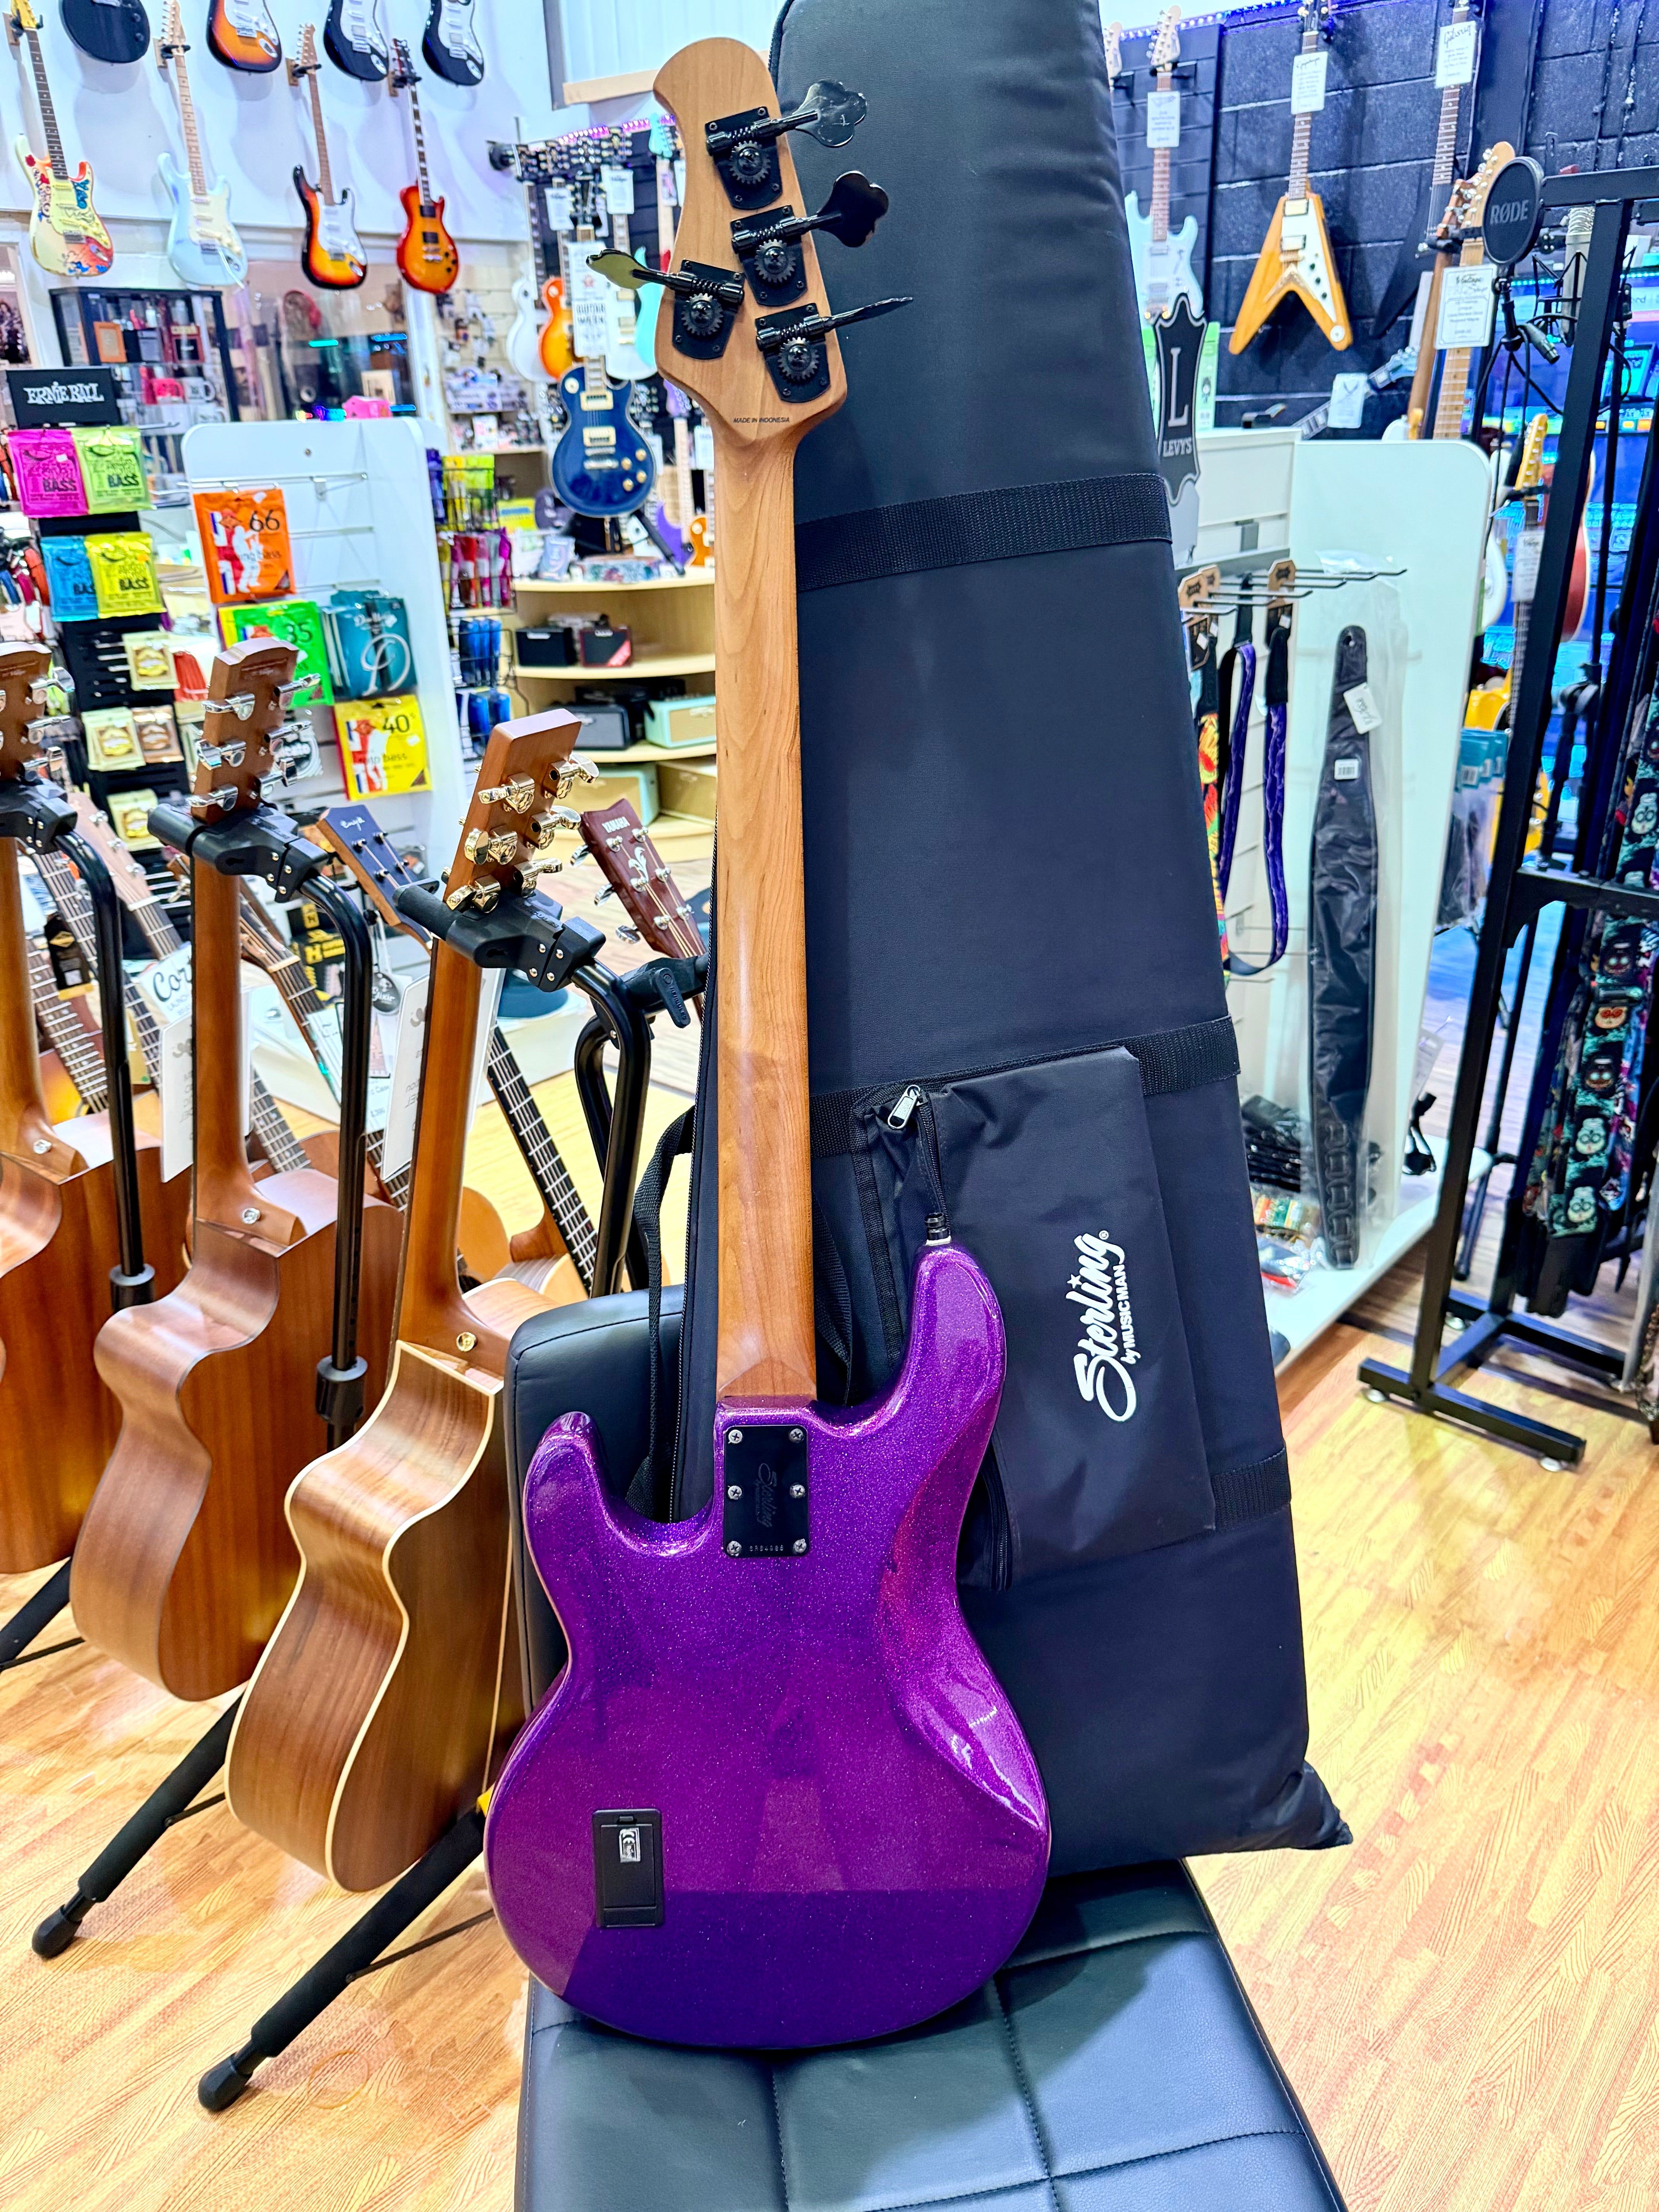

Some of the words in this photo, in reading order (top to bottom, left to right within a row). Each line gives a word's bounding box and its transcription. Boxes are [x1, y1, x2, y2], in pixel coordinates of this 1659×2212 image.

[1490, 199, 1529, 225] RØDE
[67, 383, 105, 403] BALL
[1168, 347, 1189, 427] L
[43, 477, 77, 493] BASS
[107, 474, 139, 488] BASS
[249, 509, 280, 532] 66
[73, 582, 96, 595] BAS
[119, 577, 149, 591] BASS
[601, 816, 630, 833] YAMAHA
[1113, 1264, 1130, 1300] MAN
[1066, 1233, 1137, 1422] Sterling
[1118, 1300, 1136, 1350] MUSIC
[1120, 1350, 1141, 1364] by
